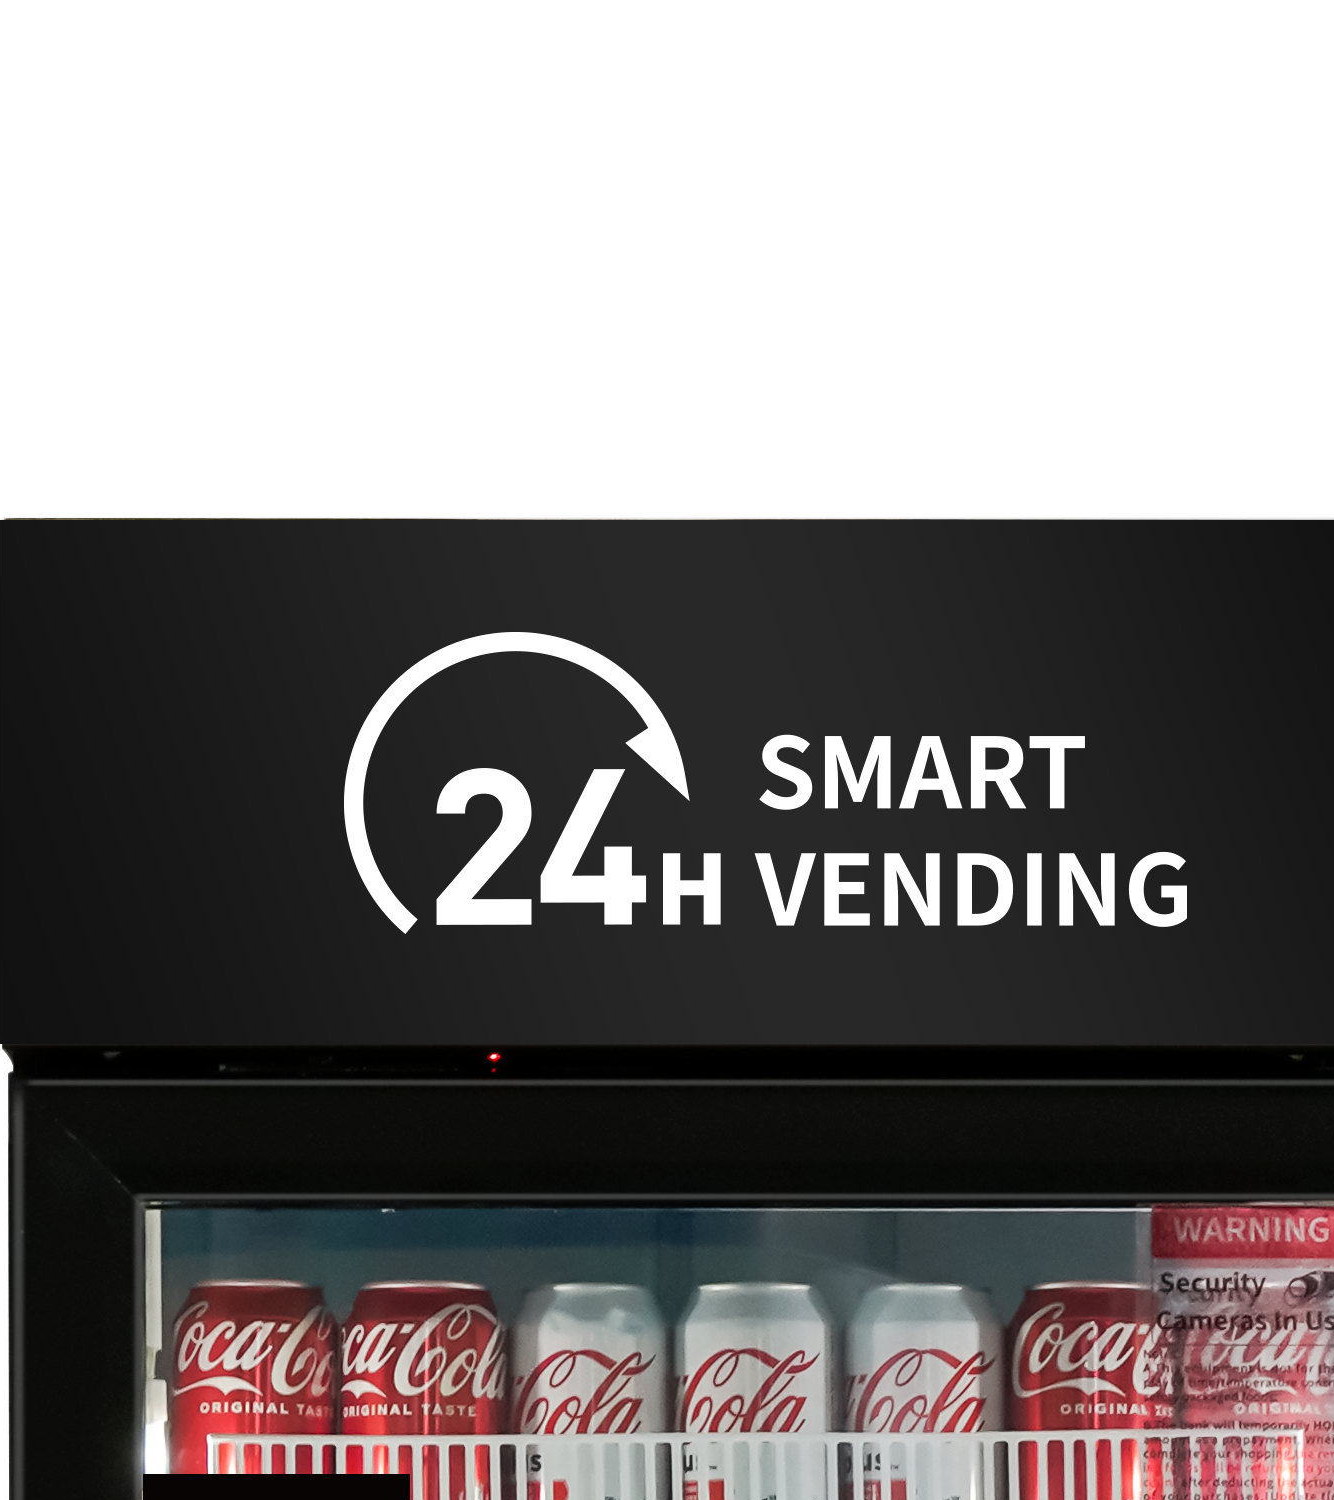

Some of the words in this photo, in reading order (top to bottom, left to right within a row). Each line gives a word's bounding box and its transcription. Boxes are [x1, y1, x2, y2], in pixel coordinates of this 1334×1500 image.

[759, 735, 1085, 810] SMART
[435, 766, 721, 926] 24H
[755, 852, 1187, 927] VENDING
[1173, 1217, 1330, 1243] WARNING
[1160, 1271, 1266, 1298] Security
[1157, 1311, 1267, 1331] Cameras
[1275, 1311, 1298, 1331] In
[199, 1401, 289, 1415] ORIGINAL
[422, 1403, 477, 1417] TASTE
[1060, 1403, 1148, 1416] ORIGINAL
